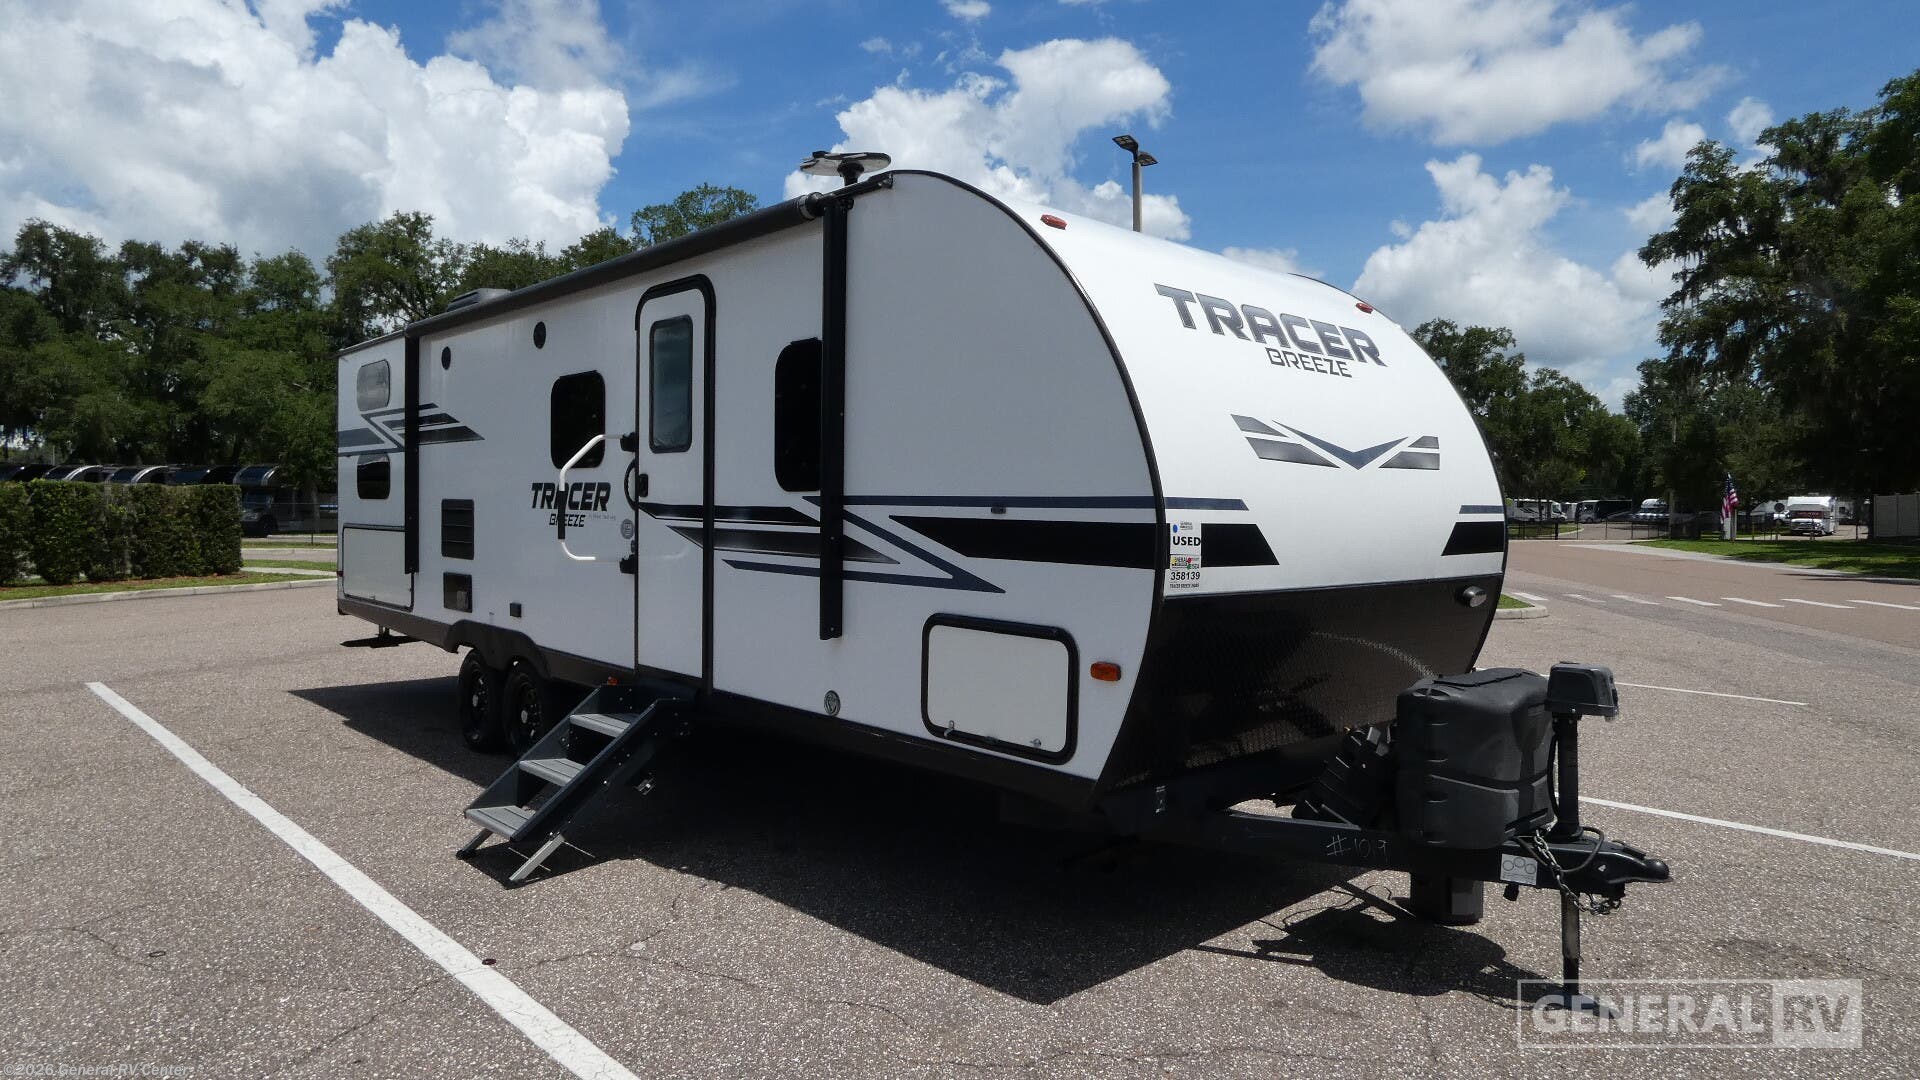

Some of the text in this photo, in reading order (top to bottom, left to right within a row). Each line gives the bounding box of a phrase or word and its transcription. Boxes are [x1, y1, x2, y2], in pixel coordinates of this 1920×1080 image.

[1154, 283, 1388, 367] TRACER
[1264, 346, 1352, 378] BREEZE
[549, 513, 586, 528] BEEZE
[1172, 535, 1201, 547] USED
[1170, 571, 1201, 581] 358139
